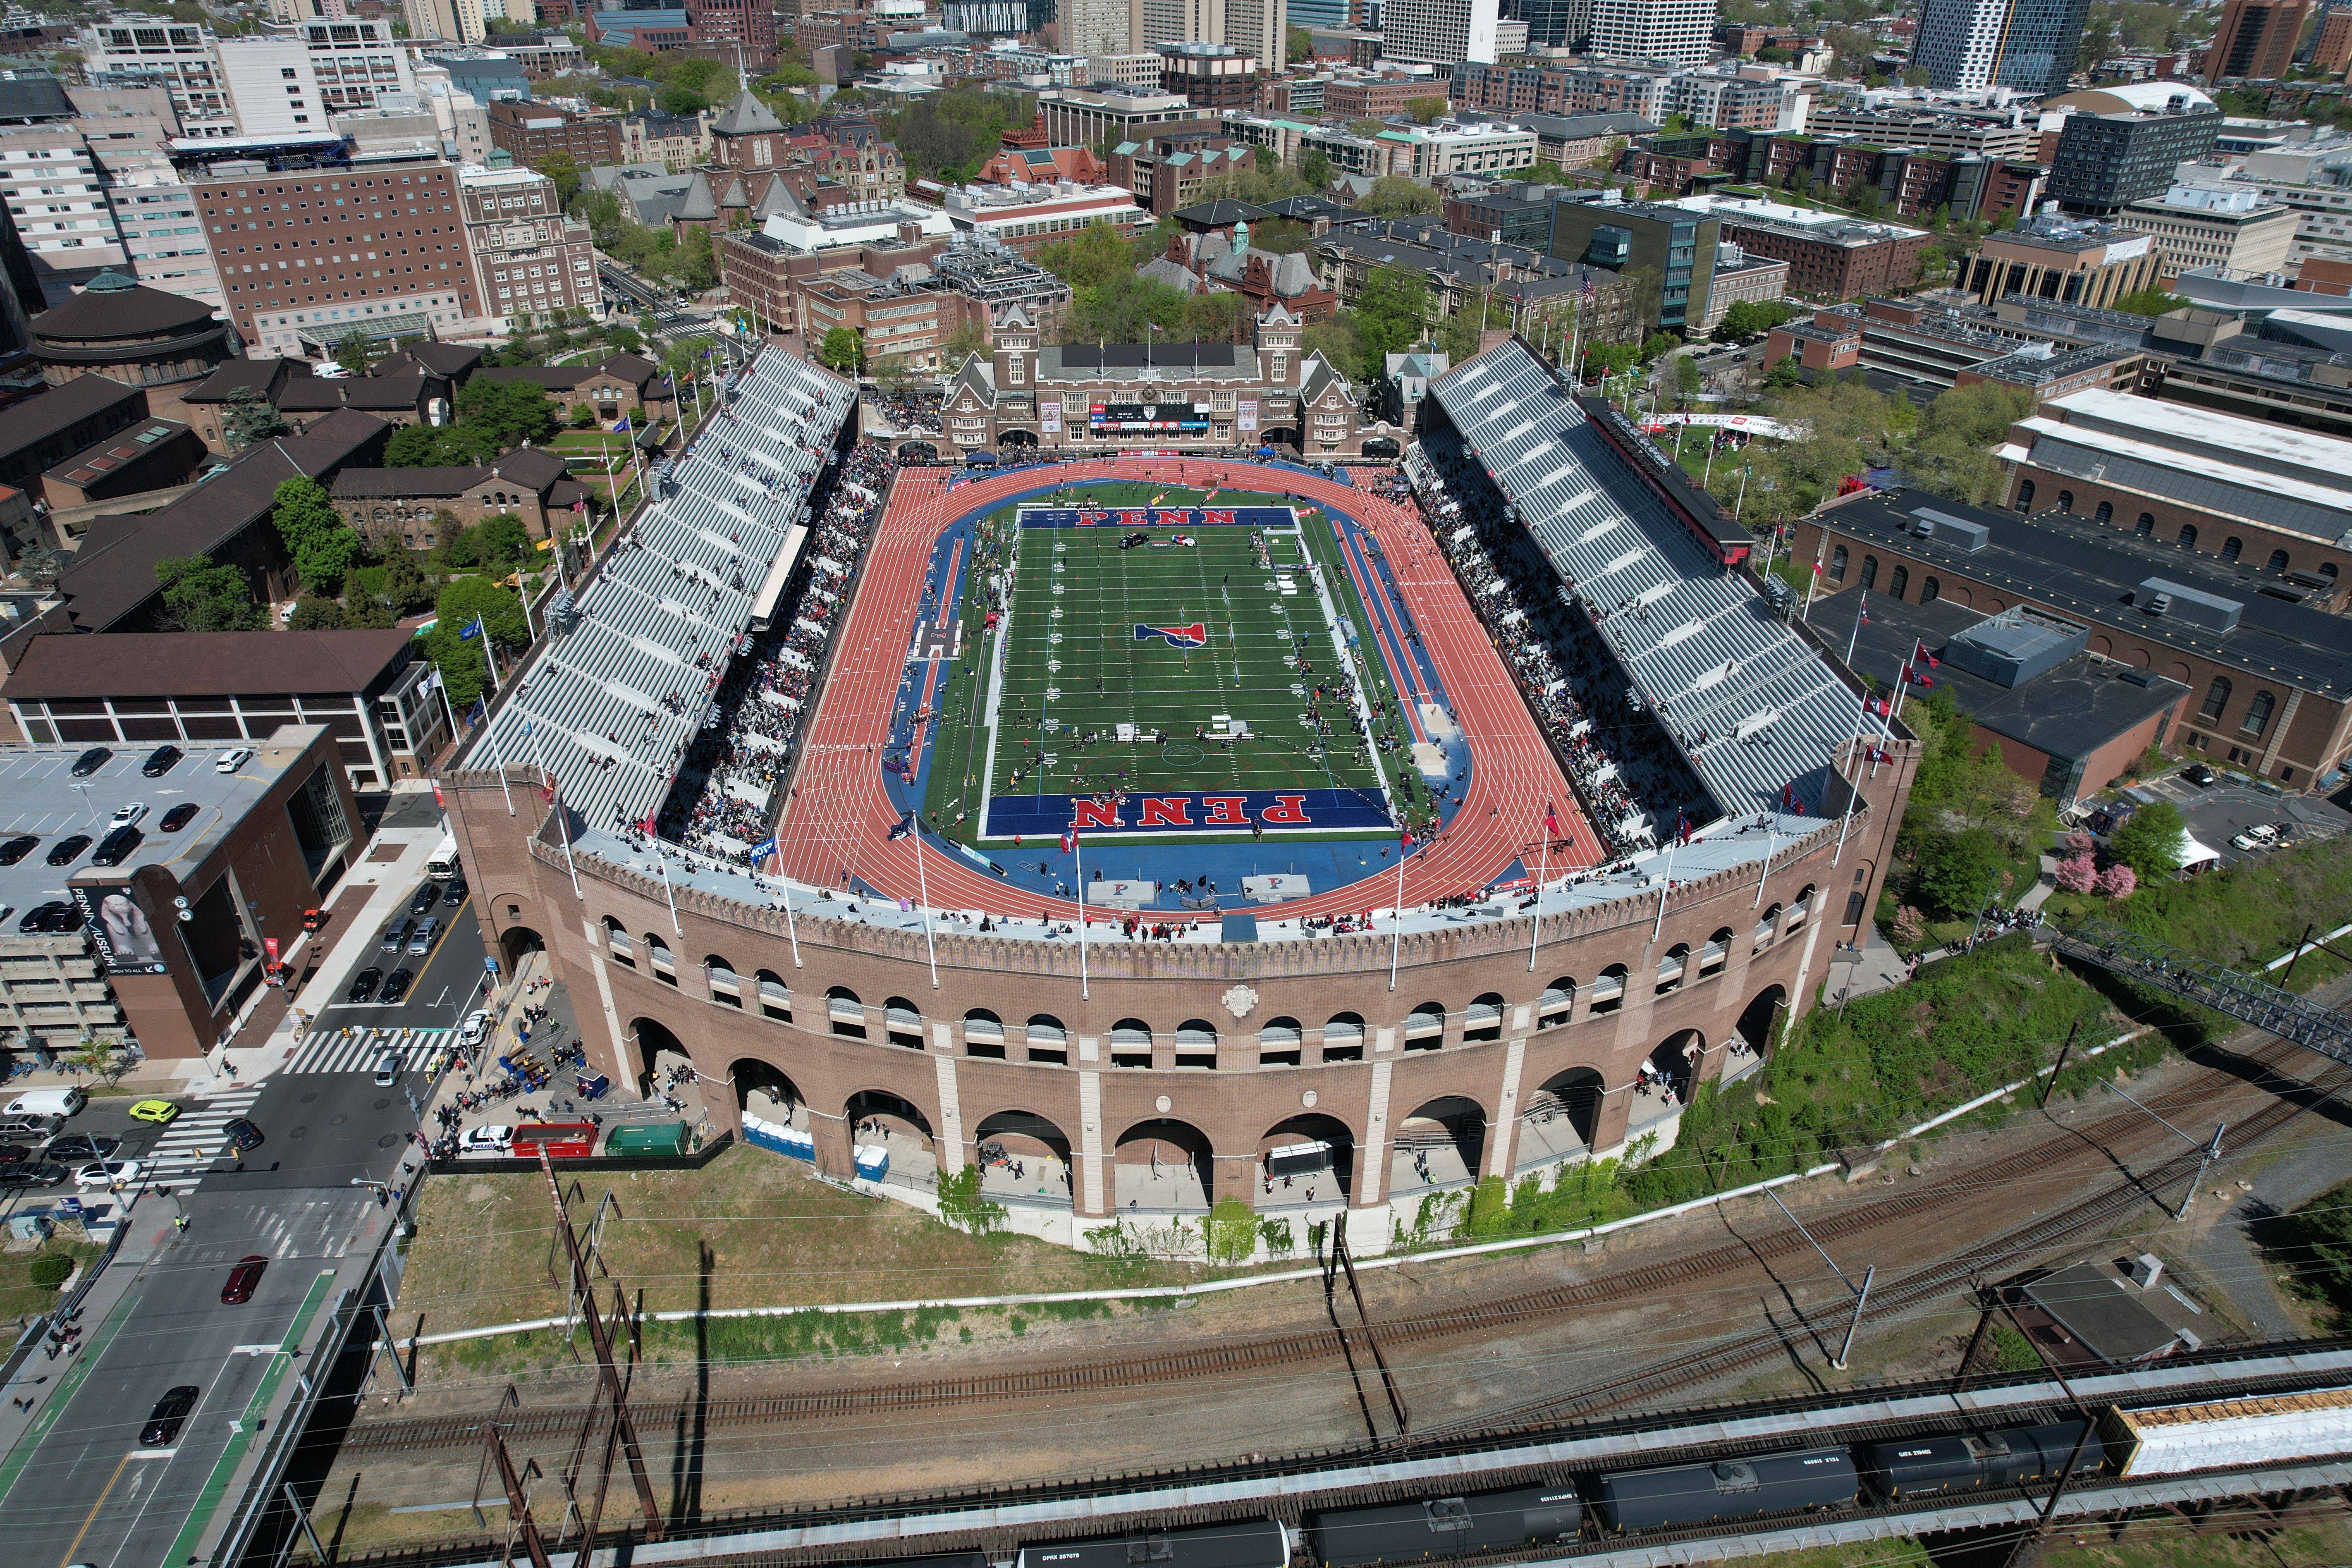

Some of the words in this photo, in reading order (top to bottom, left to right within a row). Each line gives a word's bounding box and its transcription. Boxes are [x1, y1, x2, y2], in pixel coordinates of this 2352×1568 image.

[1076, 510, 1237, 525] PENN
[1270, 605, 1283, 614] 40
[1050, 633, 1063, 643] 50
[1276, 630, 1289, 639] 50
[1048, 659, 1062, 670] 40
[1283, 655, 1297, 666] 40
[1046, 688, 1061, 699] 30
[1290, 683, 1305, 695] 30
[1045, 719, 1059, 730] 20
[1042, 753, 1058, 765] 10
[1069, 795, 1311, 828] PENN
[1268, 877, 1283, 889] P
[73, 888, 95, 915] PENN
